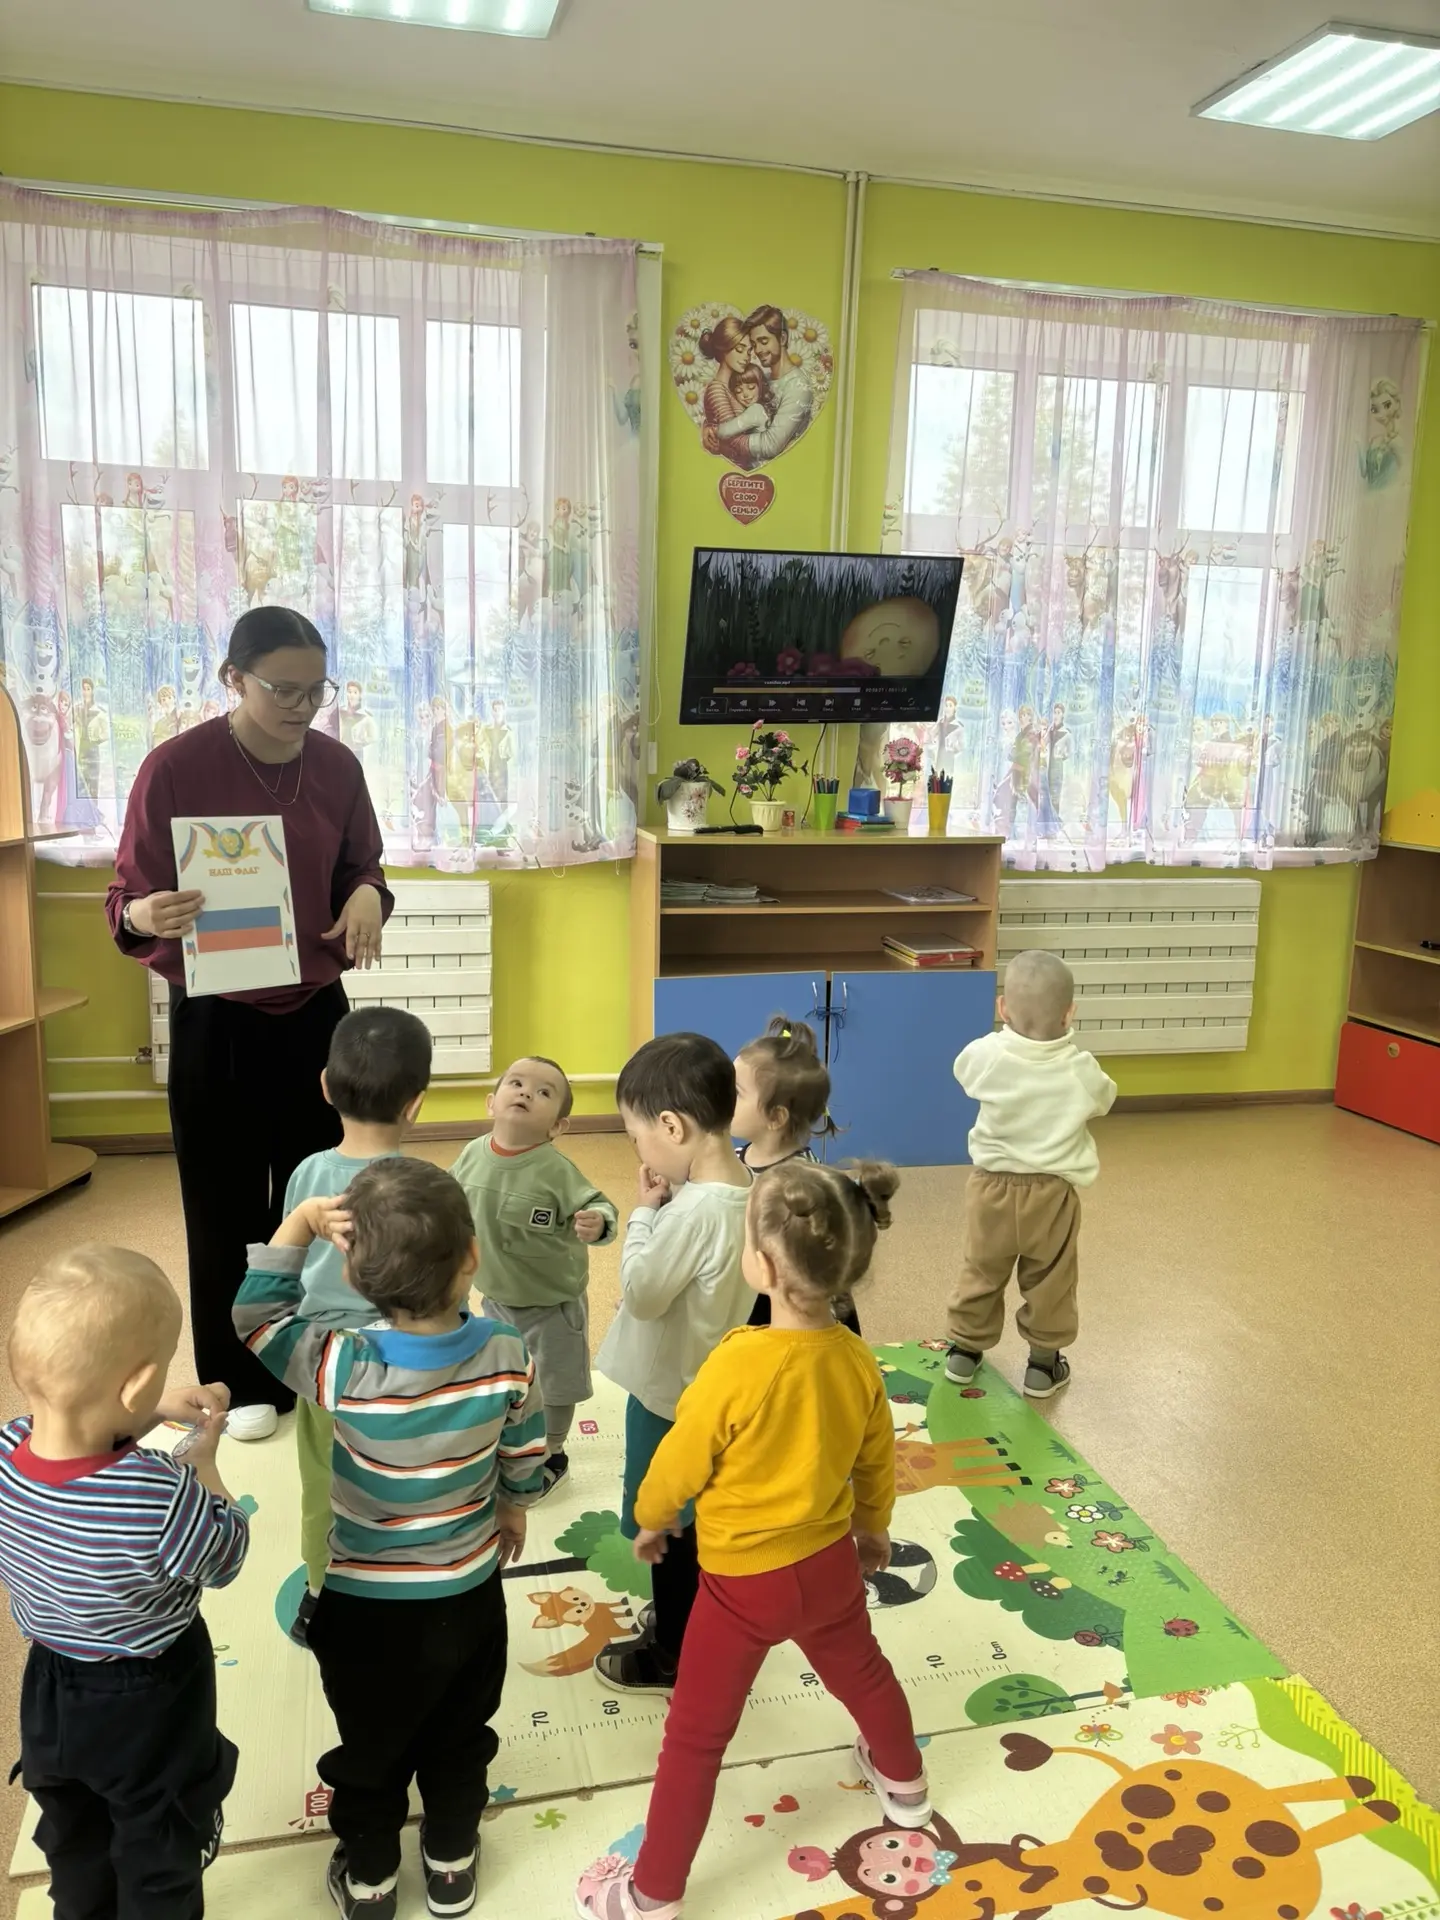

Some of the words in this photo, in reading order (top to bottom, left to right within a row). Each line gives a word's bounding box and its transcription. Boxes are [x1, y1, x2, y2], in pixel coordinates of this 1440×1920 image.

[727, 479, 764, 489] БЕРЕГИТЕ
[733, 493, 757, 501] СВОЮ
[731, 506, 759, 514] СЕМЬЮ
[209, 868, 232, 877] НАШ
[234, 866, 260, 875] ФЛАГ
[990, 1641, 1007, 1660] 0cm
[926, 1655, 945, 1668] 10
[800, 1673, 819, 1687] 30
[602, 1700, 620, 1715] 60
[531, 1711, 549, 1727] 70
[310, 1793, 328, 1814] 100
